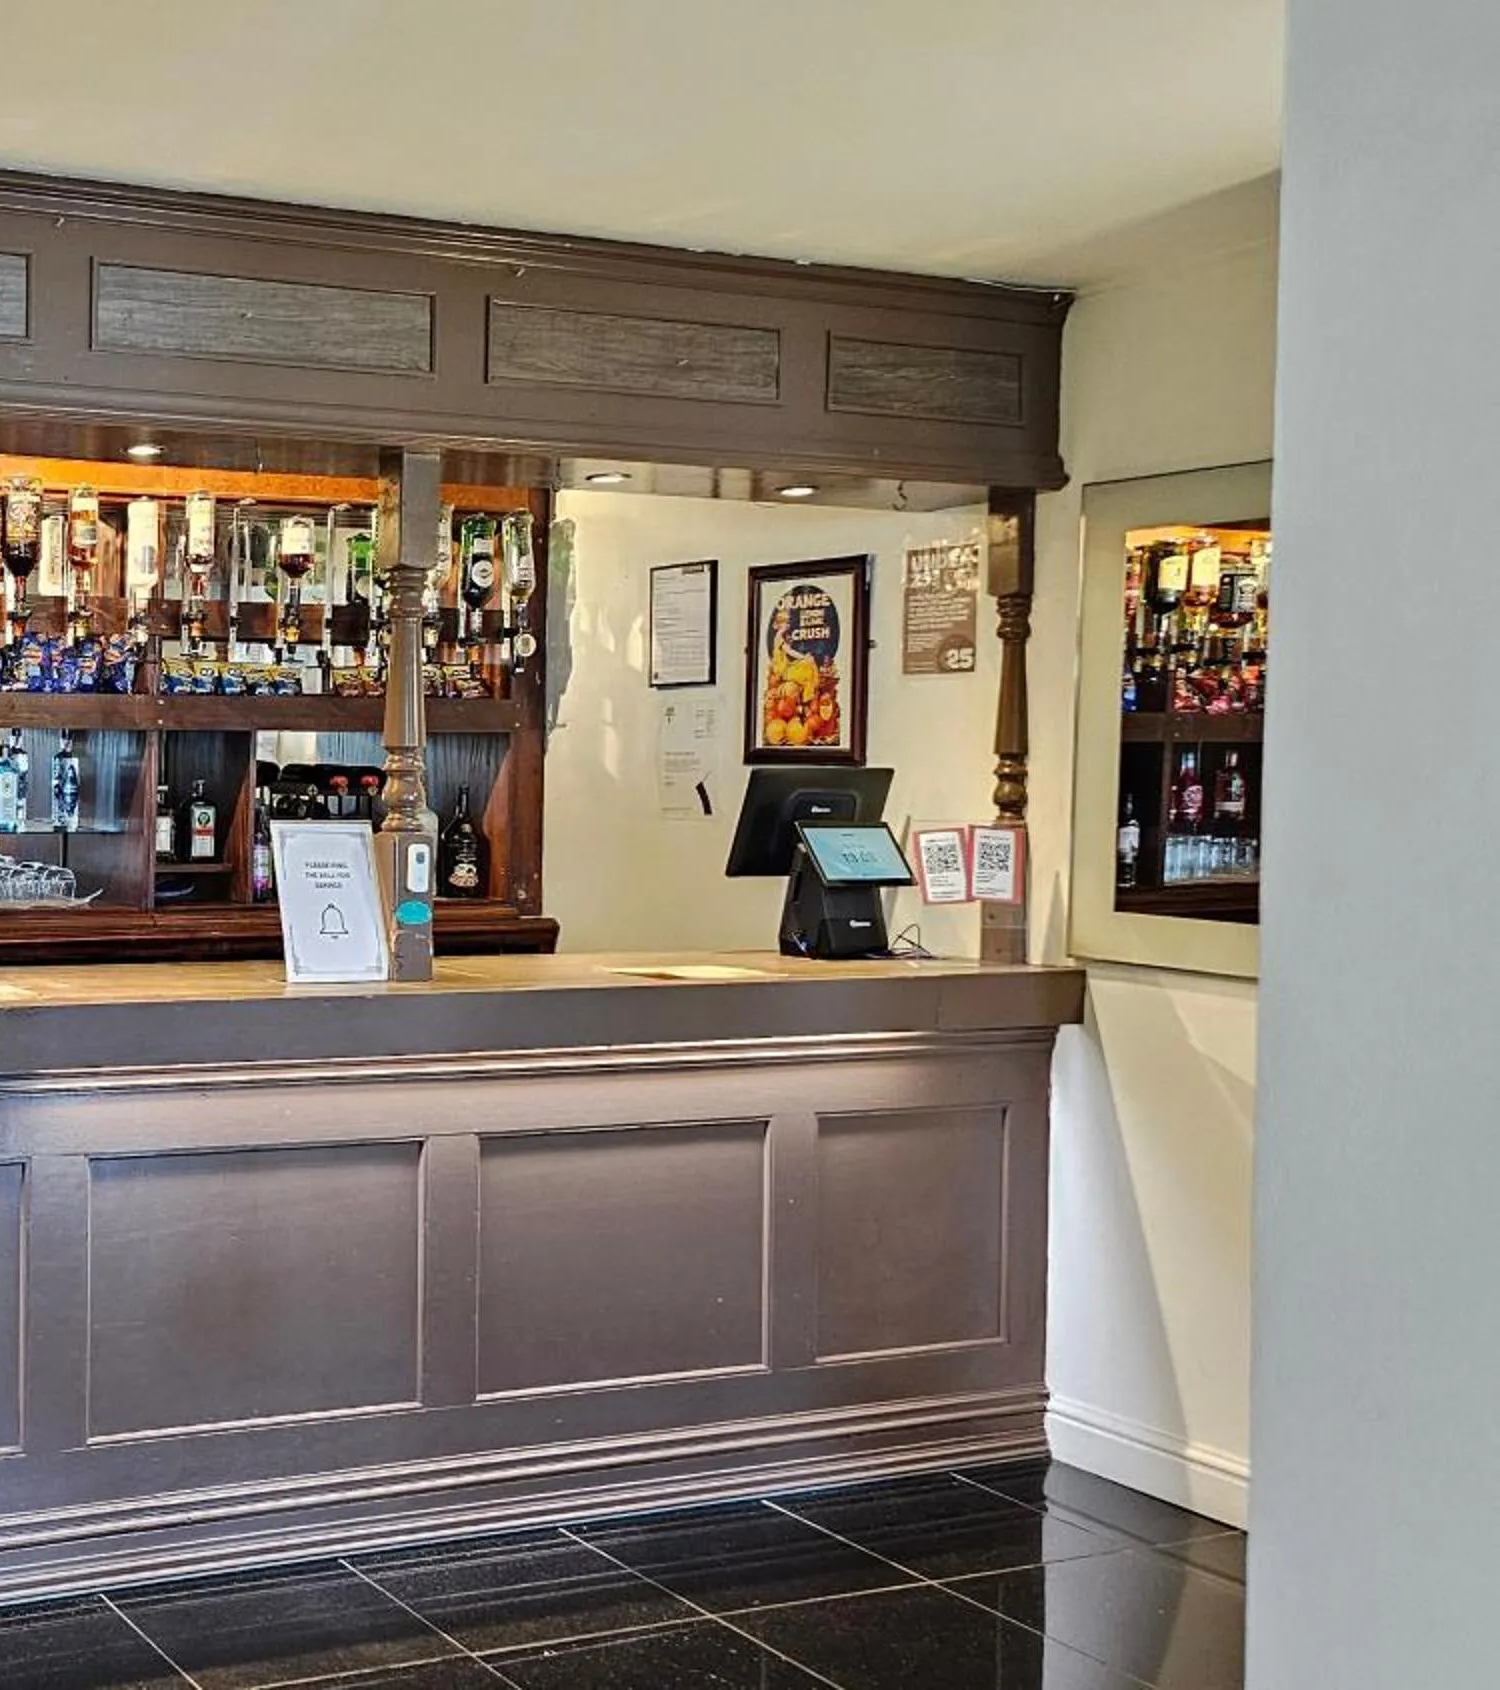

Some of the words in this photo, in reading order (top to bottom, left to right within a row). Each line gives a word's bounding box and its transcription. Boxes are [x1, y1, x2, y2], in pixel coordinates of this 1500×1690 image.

[776, 592, 833, 610] ORANGE
[791, 626, 831, 641] CRUSH
[945, 647, 975, 670] 25
